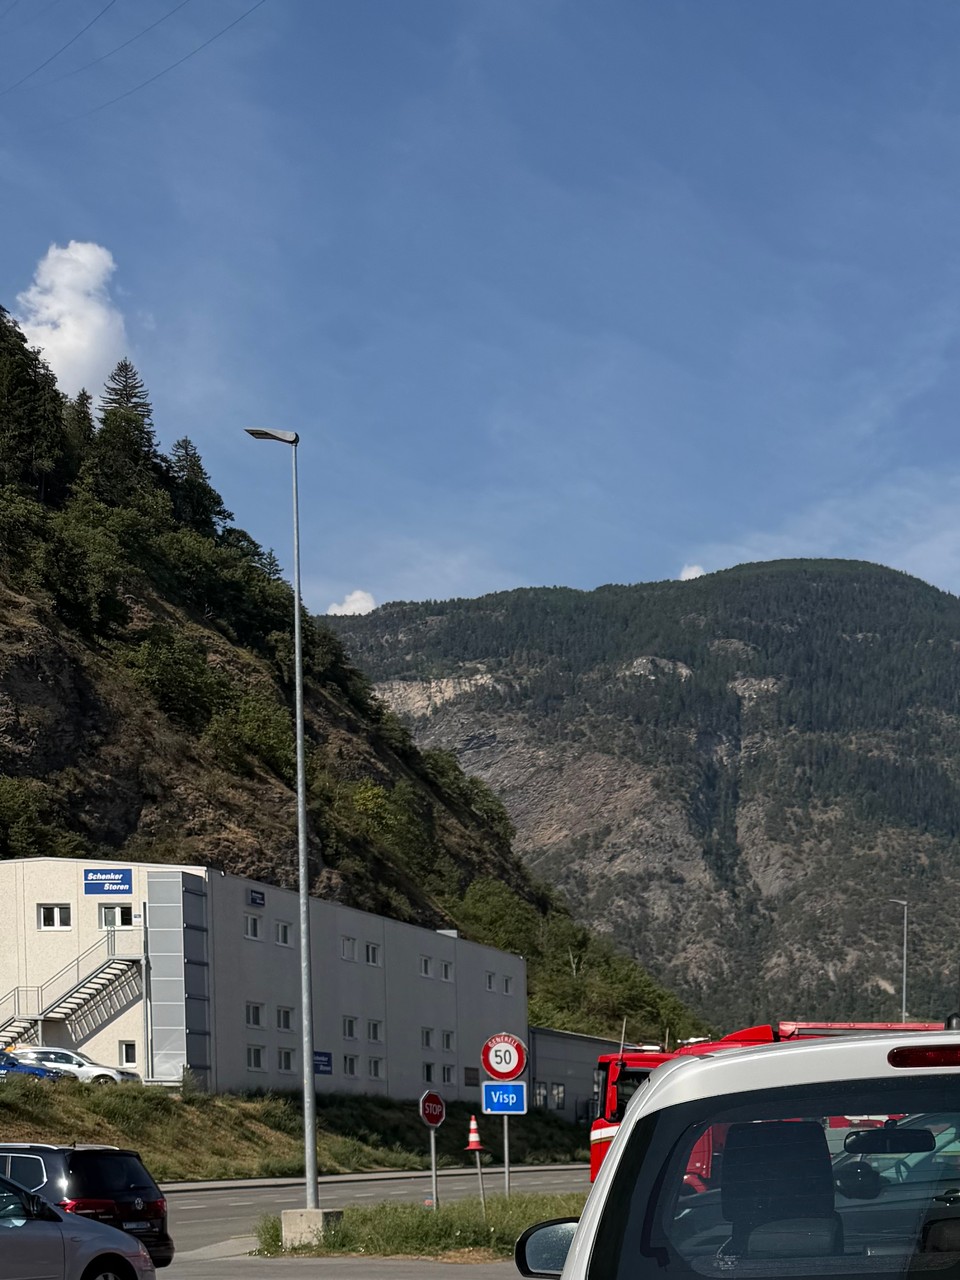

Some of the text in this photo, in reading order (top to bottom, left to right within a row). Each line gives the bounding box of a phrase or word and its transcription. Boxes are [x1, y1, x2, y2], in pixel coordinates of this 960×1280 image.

[87, 872, 123, 881] Schenker
[103, 883, 130, 891] Storen
[494, 1049, 512, 1065] 50
[490, 1091, 517, 1106] Visp
[425, 1102, 442, 1115] STOP
